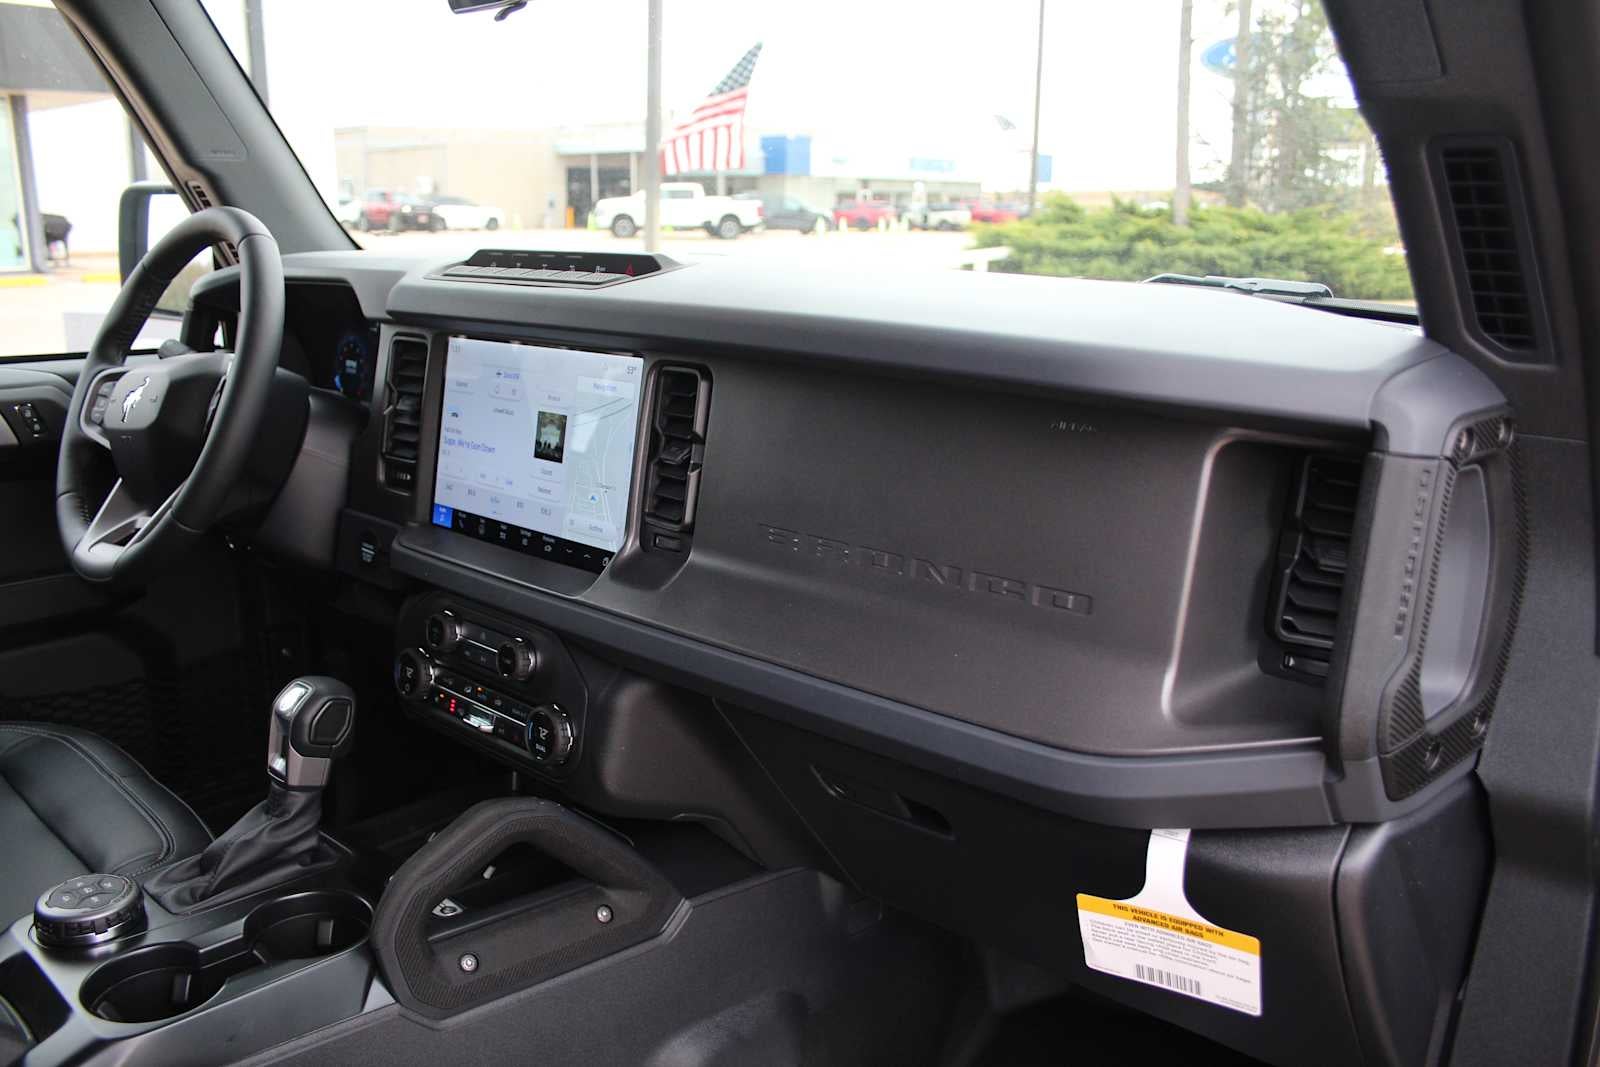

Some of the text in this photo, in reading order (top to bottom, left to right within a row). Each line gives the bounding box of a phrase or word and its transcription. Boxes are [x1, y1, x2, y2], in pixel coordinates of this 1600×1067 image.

[758, 523, 1093, 616] BRONCO
[1112, 903, 1224, 937] THIS VEHICLE IS EQUIPPED WITH
[1132, 913, 1204, 939] ADVANCED AIR BAGS
